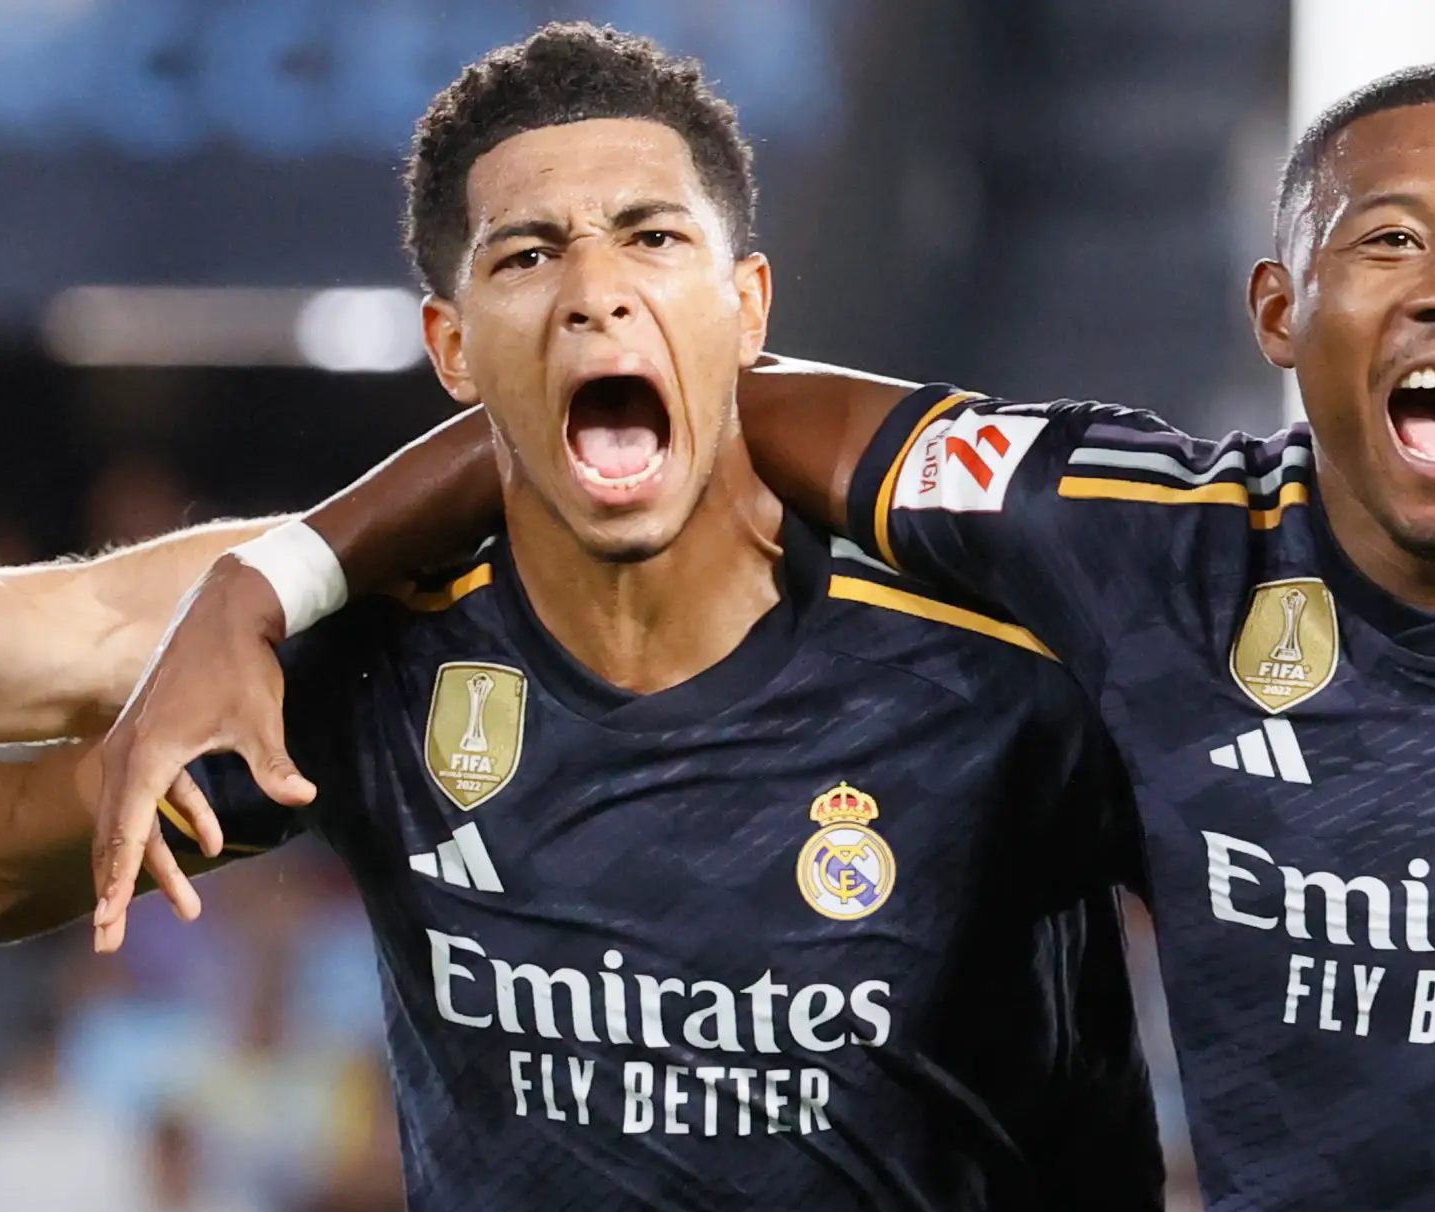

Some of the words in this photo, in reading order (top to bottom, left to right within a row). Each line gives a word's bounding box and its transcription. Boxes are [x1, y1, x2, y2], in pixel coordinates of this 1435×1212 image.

[919, 433, 946, 494] LIGA
[1259, 661, 1305, 680] FIFA
[451, 754, 492, 773] FIFA
[424, 927, 892, 1054] Emirates
[1282, 954, 1386, 1037] FLY
[509, 1050, 595, 1125] FLY
[621, 1060, 833, 1137] BETTER
